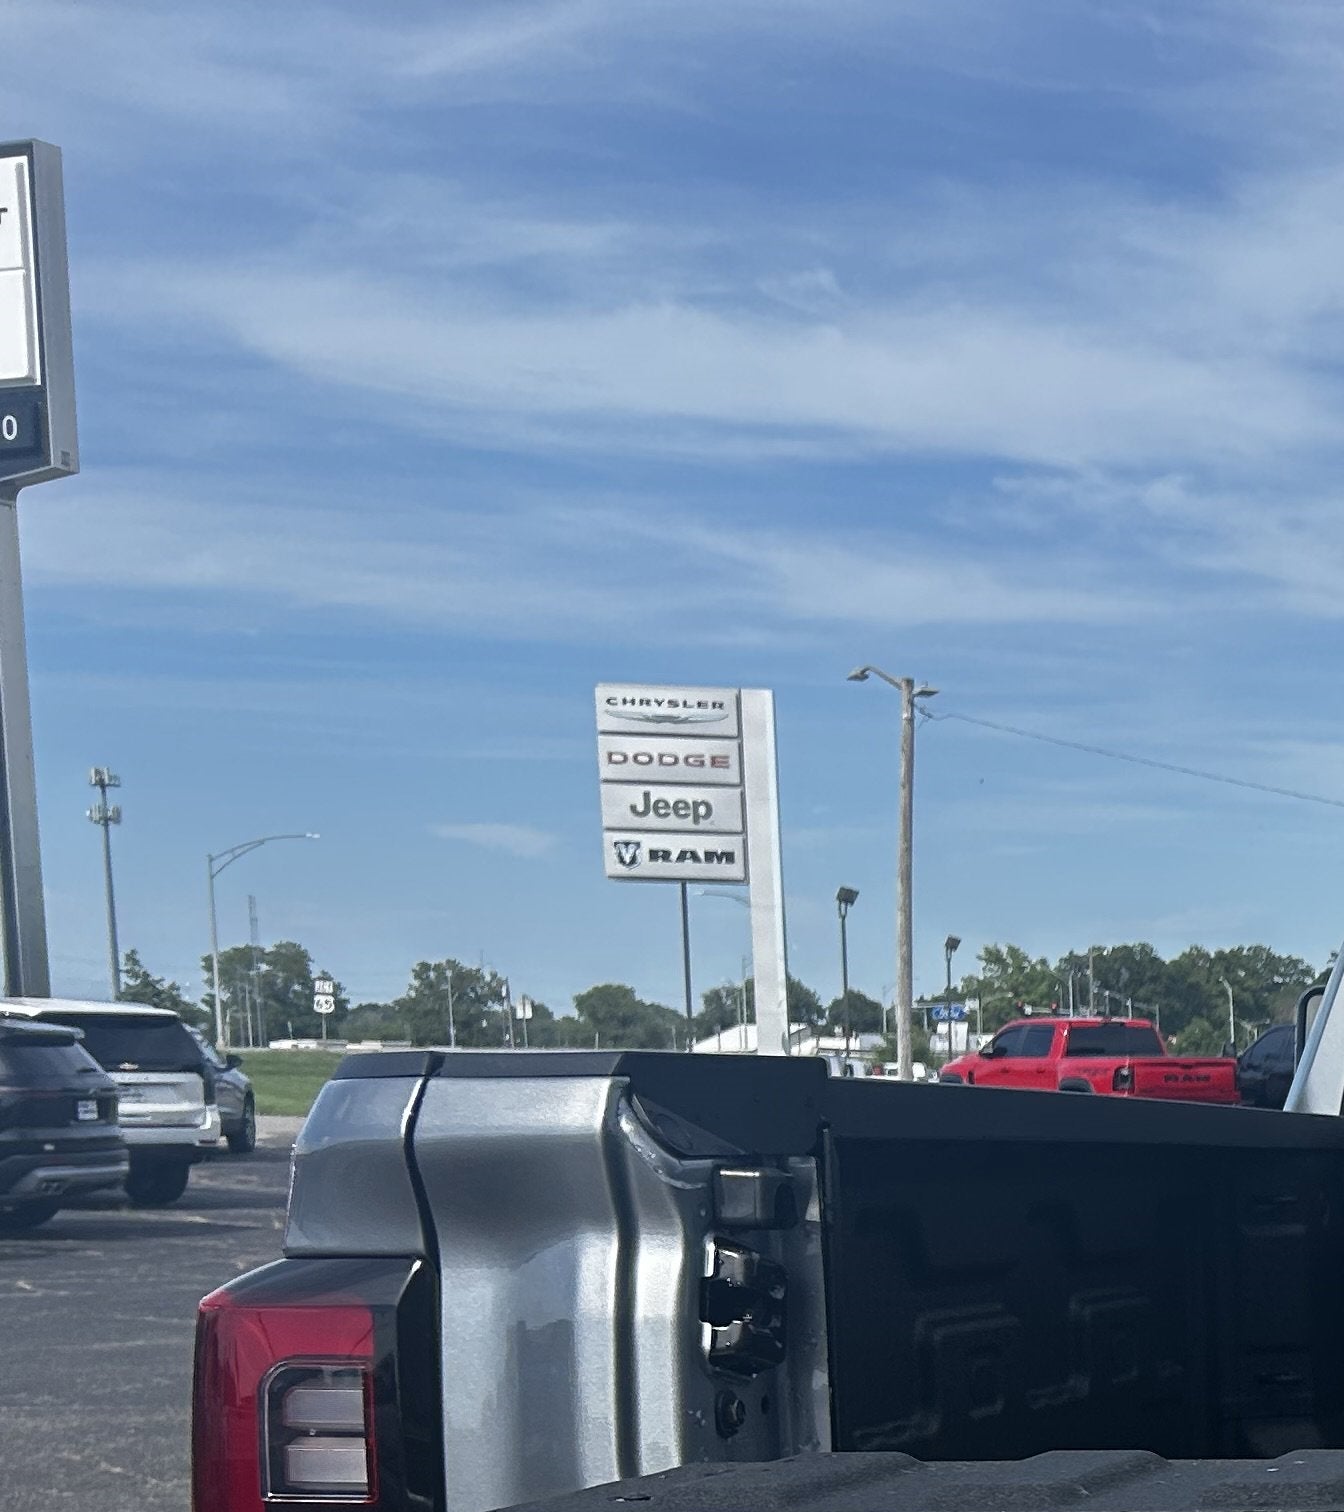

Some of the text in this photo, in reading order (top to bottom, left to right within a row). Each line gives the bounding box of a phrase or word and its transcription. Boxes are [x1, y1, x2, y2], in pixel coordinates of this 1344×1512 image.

[605, 696, 725, 710] CHRYSLER
[607, 751, 730, 769] DODGE
[629, 791, 713, 826] Jeep
[648, 849, 736, 865] RAM
